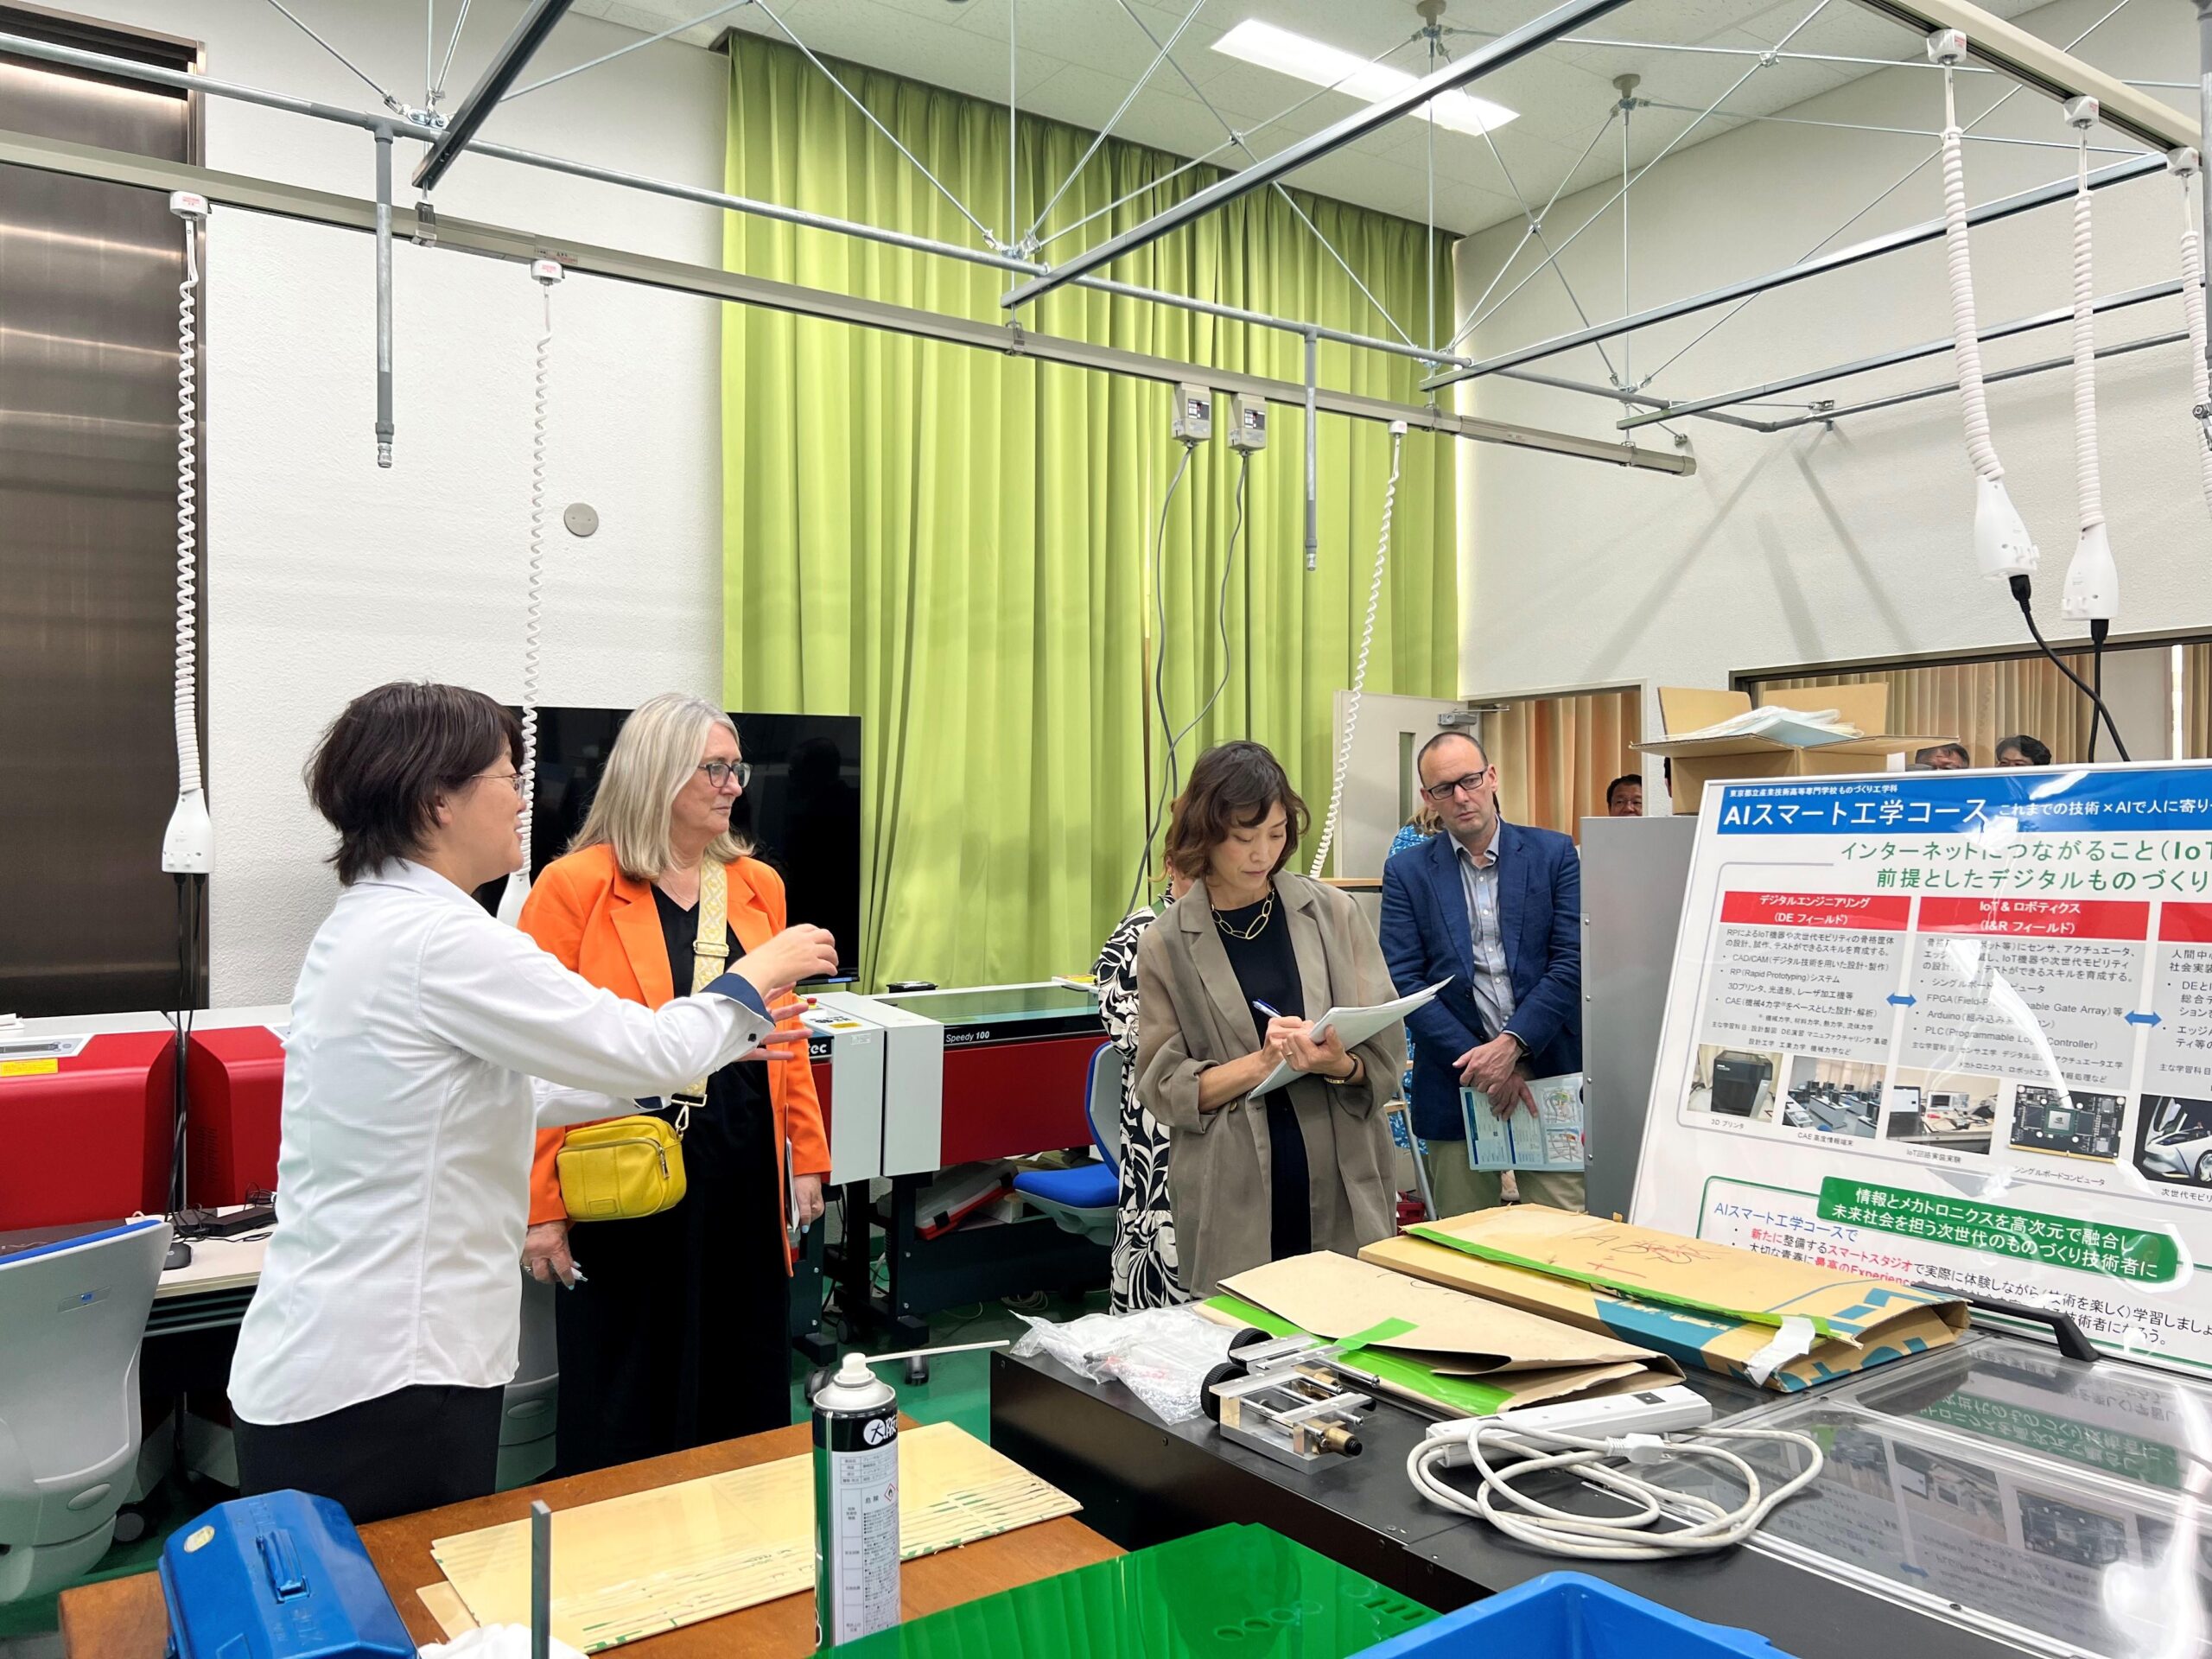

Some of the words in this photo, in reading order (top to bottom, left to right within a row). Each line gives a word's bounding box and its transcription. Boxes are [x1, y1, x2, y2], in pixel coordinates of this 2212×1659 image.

[1840, 785, 1897, 795] ものづくり工学科
[1723, 798, 1988, 826] AIスマート工学コース
[1999, 798, 2212, 817] これまでの技術×AIで人に寄り
[1877, 868, 2208, 893] 前提としたデジタルものづくり
[1759, 894, 1871, 908] デジタルエンジニアリング
[2014, 901, 2081, 914] ロボティクス
[2054, 1003, 2076, 1013] Gate
[946, 1033, 974, 1043] Speedy
[976, 1031, 990, 1040] 100
[1714, 1202, 1858, 1243] AIスマート工学コースで
[1856, 1187, 2133, 1252] 情報とメカトロニクスを高次元で融合し
[1832, 1204, 2158, 1278] 未来社会を担う次世代のものづくり技術者に
